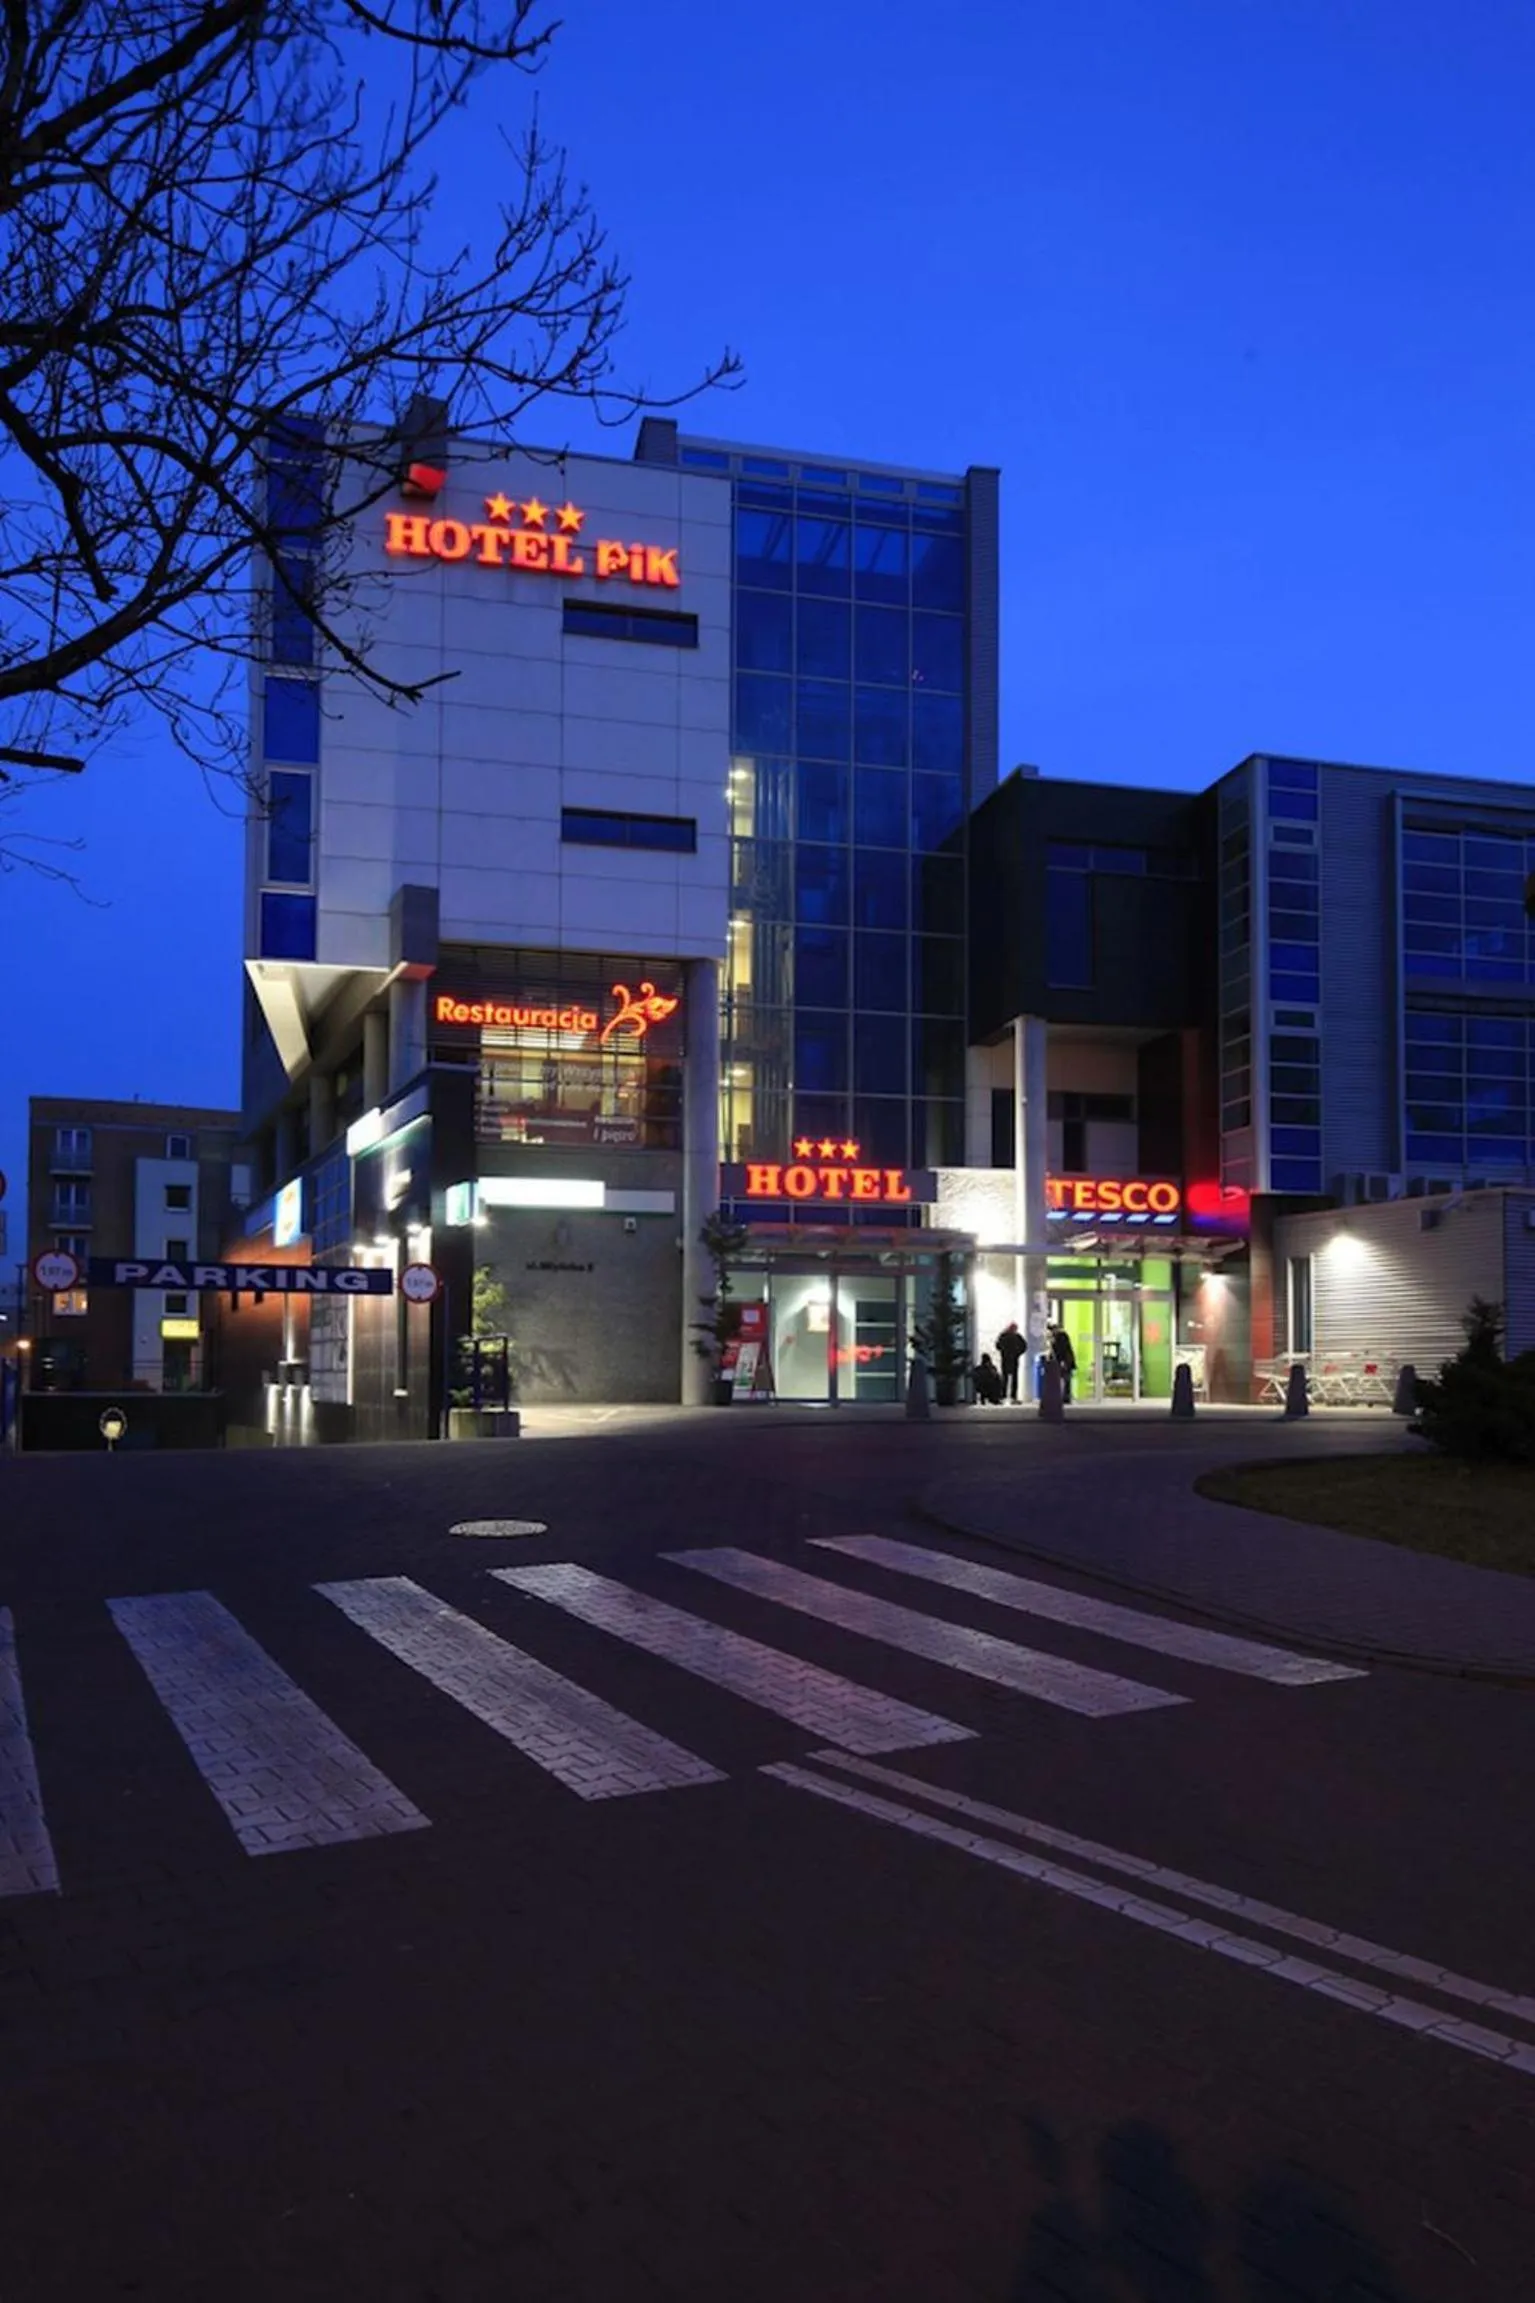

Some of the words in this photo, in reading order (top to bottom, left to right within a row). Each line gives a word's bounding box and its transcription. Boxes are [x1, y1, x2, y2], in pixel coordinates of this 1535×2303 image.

[385, 512, 584, 574] HOTEL
[436, 996, 598, 1033] Restauracja
[746, 1164, 912, 1201] HOTEL
[1046, 1179, 1180, 1212] TESCO
[114, 1262, 369, 1291] PARKING
